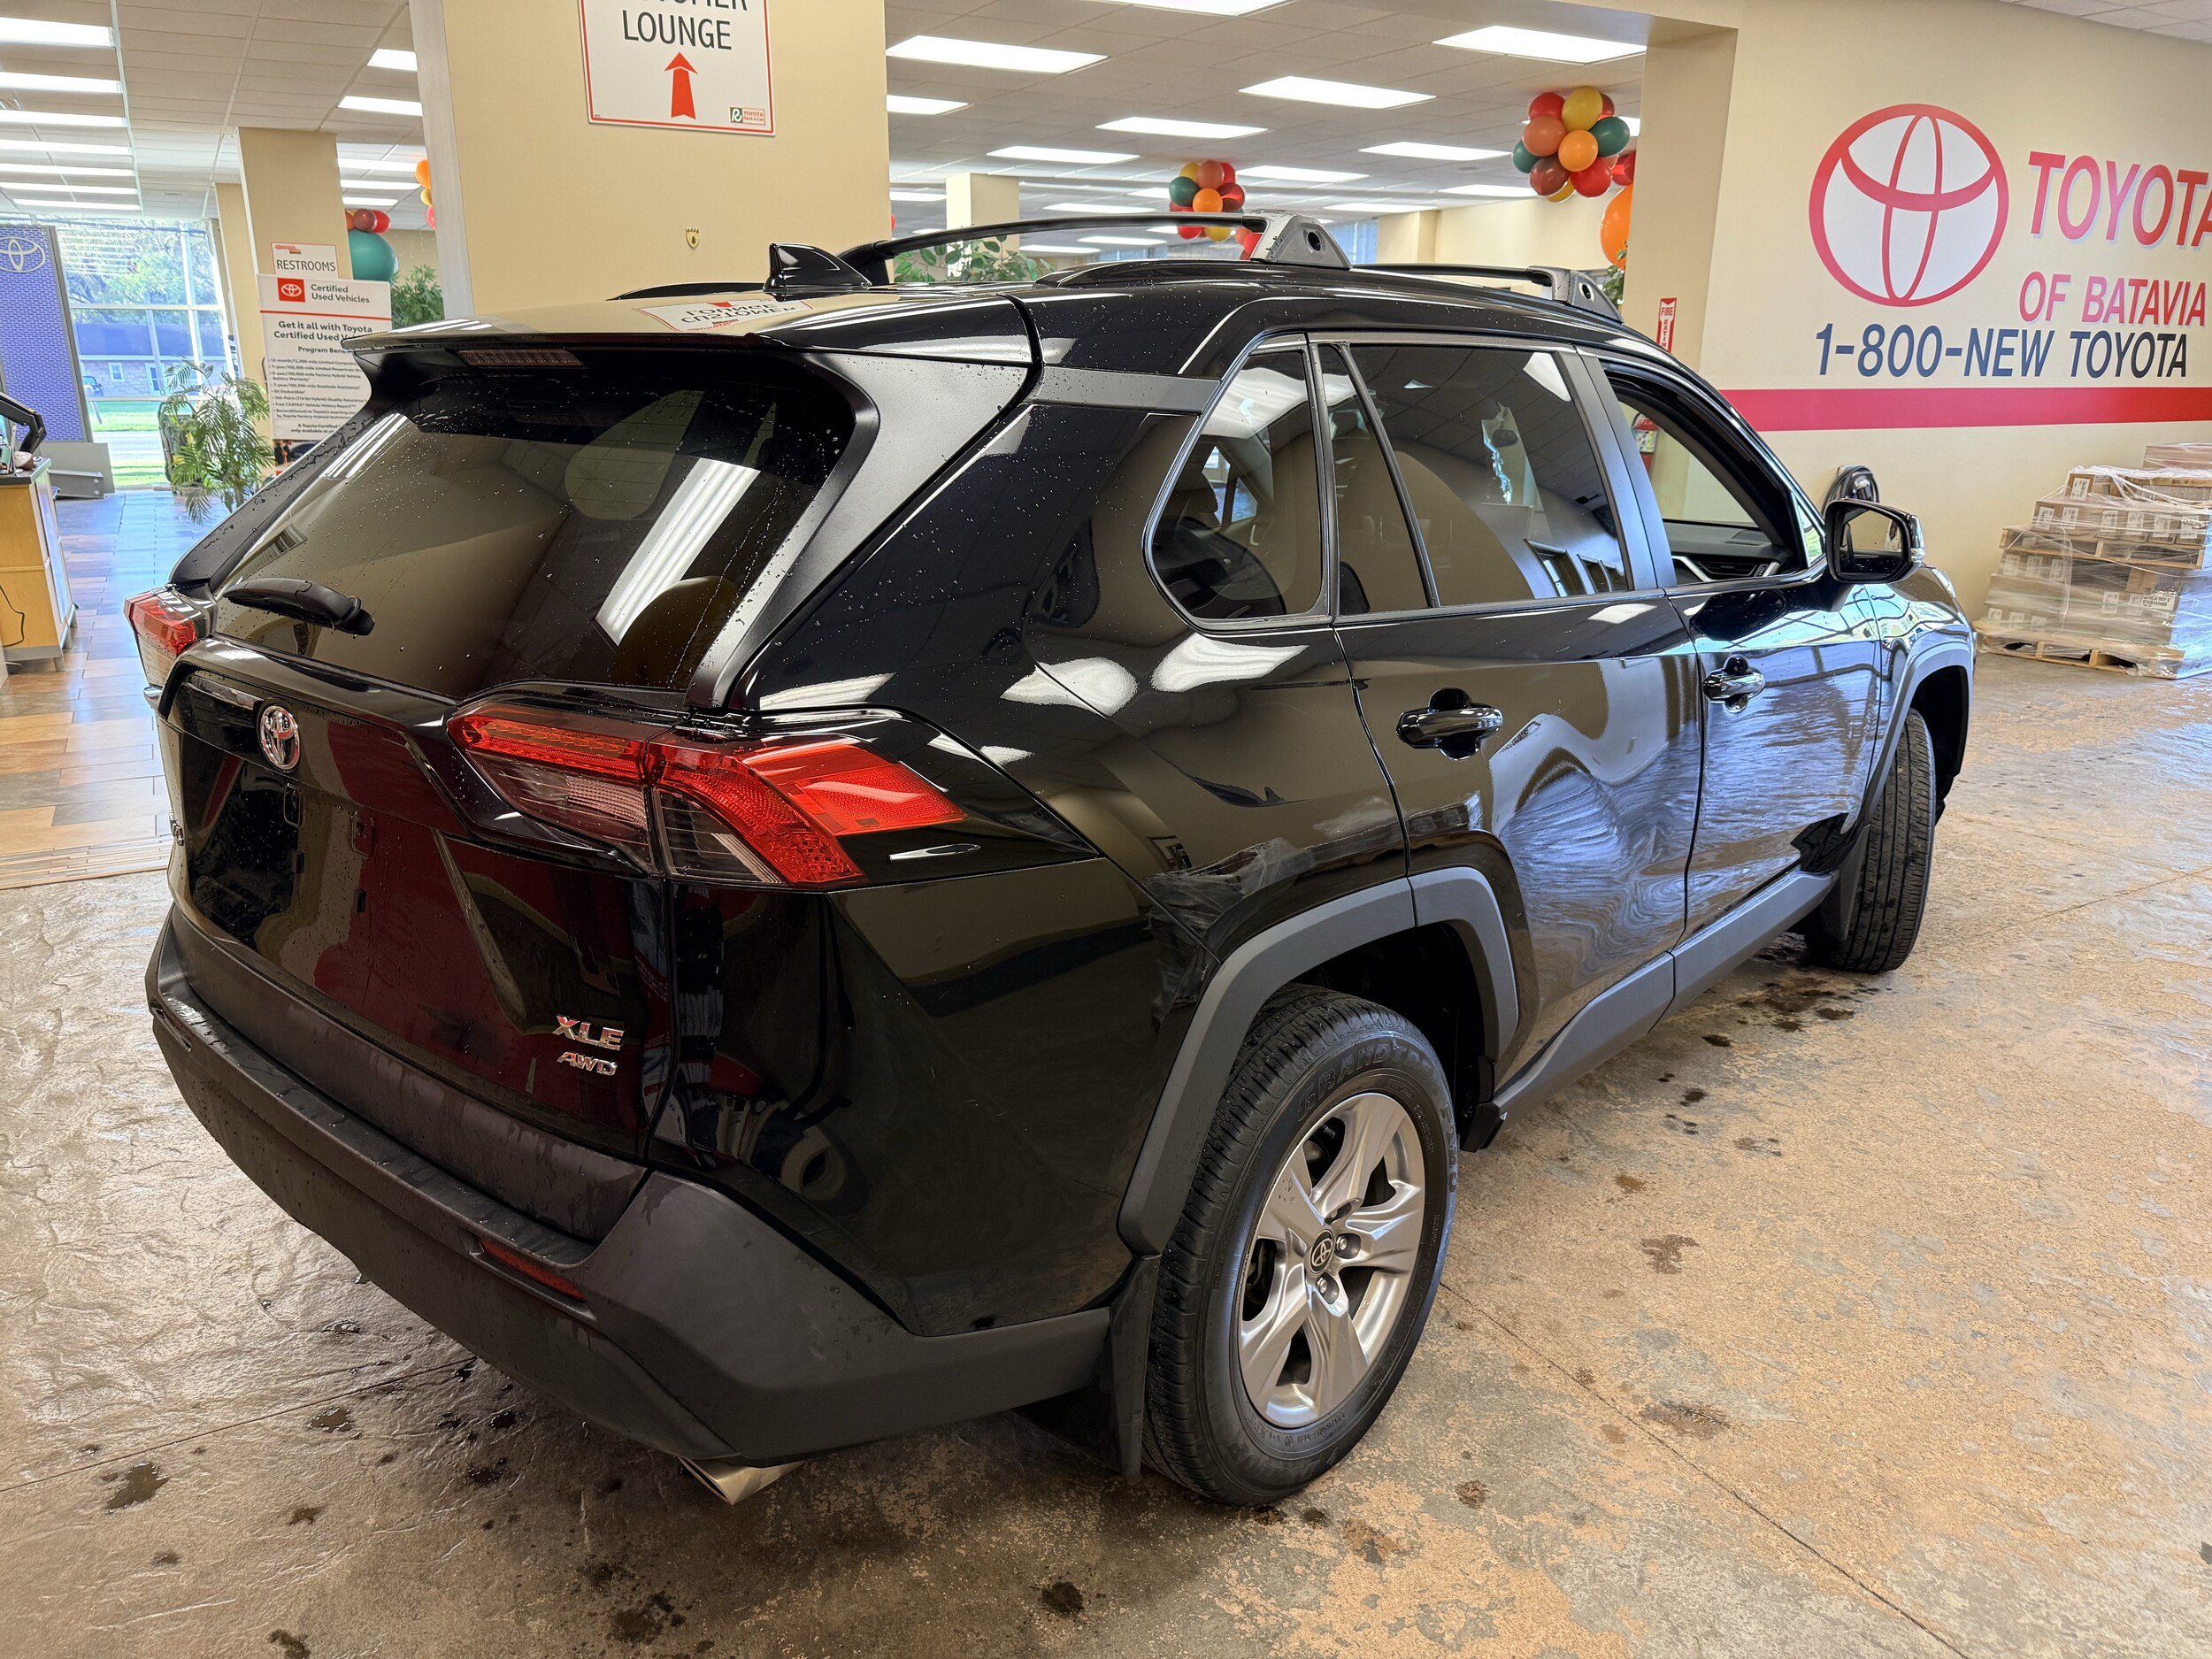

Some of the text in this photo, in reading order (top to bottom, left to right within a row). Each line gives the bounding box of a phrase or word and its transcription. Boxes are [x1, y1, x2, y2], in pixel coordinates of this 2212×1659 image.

[622, 10, 733, 50] LOUNGE
[276, 259, 336, 272] RESTROOMS
[311, 283, 349, 294] Certified
[335, 295, 370, 303] Vehicles
[2018, 270, 2207, 327] OF BATAVIA
[1662, 307, 1673, 316] FIRE
[279, 320, 296, 329] Get
[297, 320, 303, 329] it
[319, 322, 341, 331] with
[342, 324, 373, 334] Toyota
[274, 331, 314, 340] Certified
[317, 332, 340, 342] Used
[1816, 322, 2188, 379] 1-800-NEW TOYOTA
[551, 1014, 625, 1051] XLE
[556, 1051, 618, 1077] AWD
